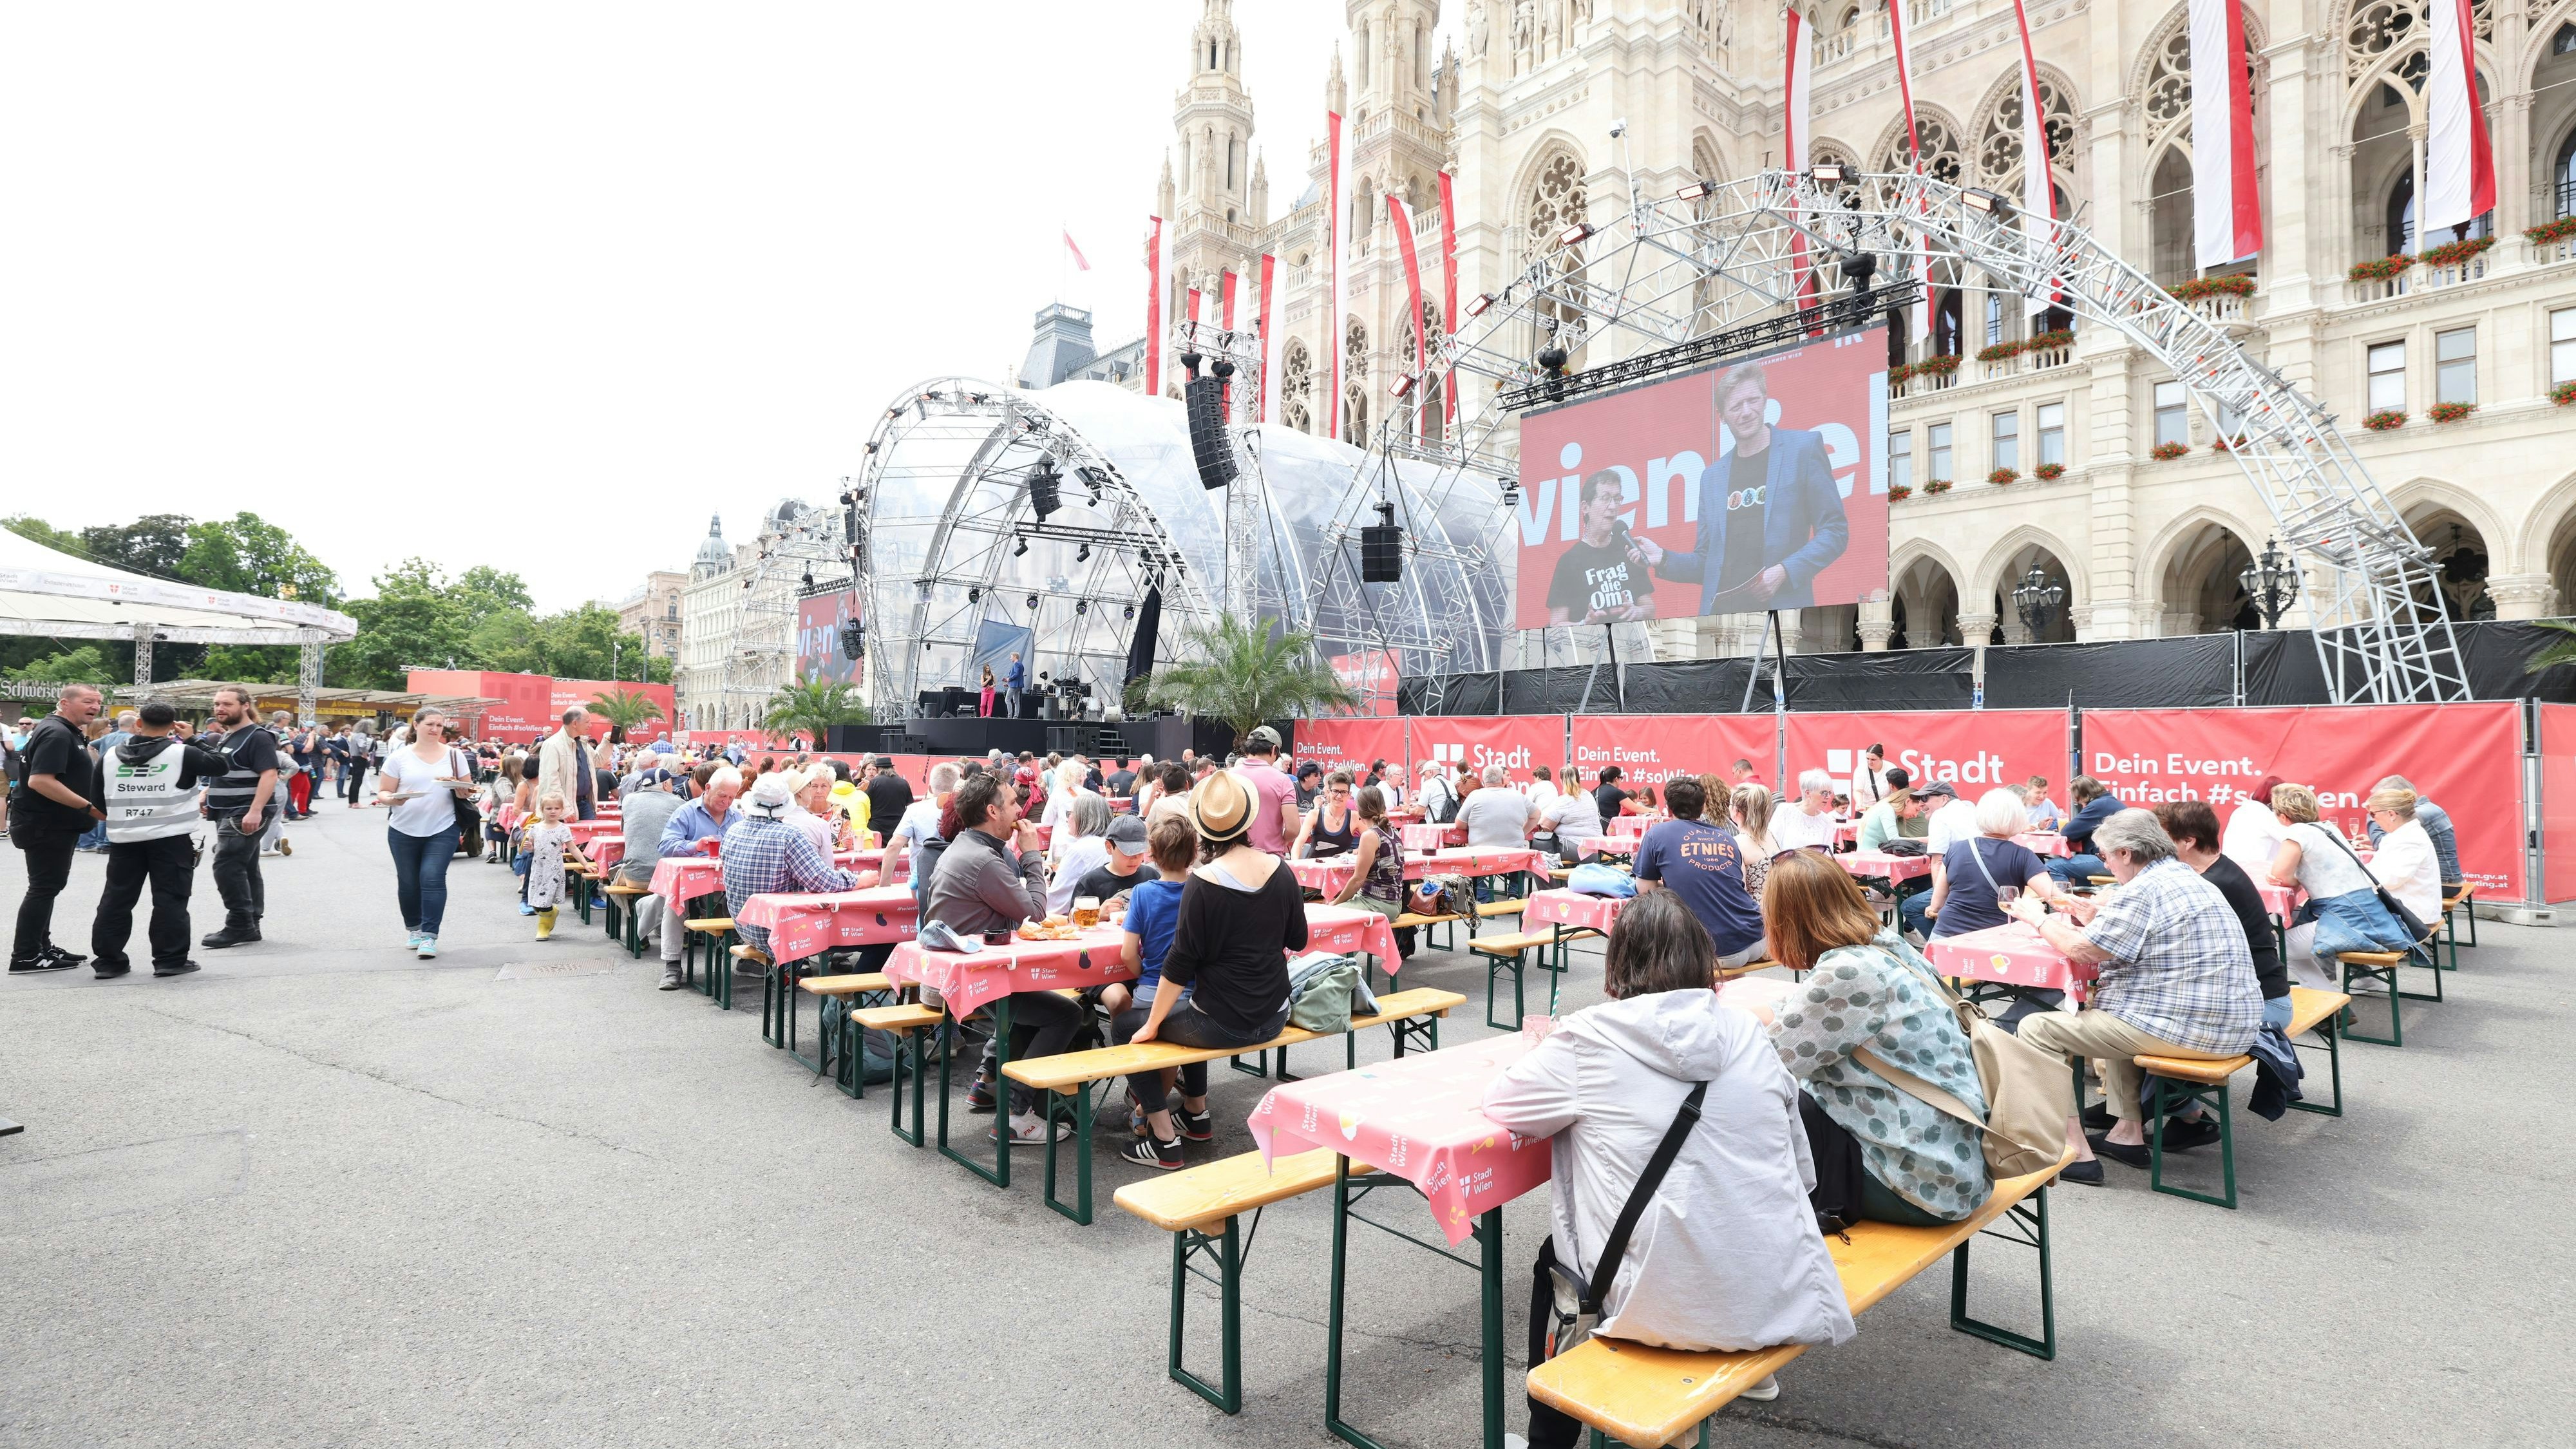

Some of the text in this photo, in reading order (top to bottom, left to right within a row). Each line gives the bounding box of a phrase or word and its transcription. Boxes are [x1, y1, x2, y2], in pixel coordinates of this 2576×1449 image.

[1586, 562, 1629, 585] Frag
[1600, 580, 1622, 592] die
[1297, 742, 1343, 755] Dein Event.
[1578, 746, 1661, 763] Dein Event.
[1473, 744, 1531, 770] Stadt
[2095, 752, 2262, 777] Dein Event.
[1900, 749, 2004, 784] Stadt
[117, 783, 166, 792] Steward
[126, 808, 154, 817] R747
[1683, 829, 1729, 842] QUALITY
[1680, 842, 1735, 859] ETNIES
[1689, 858, 1733, 871] PRODUCTS
[943, 979, 958, 994] Stadt
[947, 985, 961, 999] Wien
[974, 979, 988, 989] Stadt
[974, 986, 989, 995] Wien
[1302, 1102, 1312, 1130] Stadt
[1309, 1104, 1318, 1133] Wien
[1023, 1125, 1036, 1137] FILA
[1389, 1133, 1399, 1165] Stadt
[1397, 1137, 1408, 1168] Wien
[1426, 1161, 1447, 1188] Stadt
[1473, 1167, 1493, 1183] Stadt
[1431, 1173, 1452, 1196] Wien
[1473, 1180, 1493, 1195] Wien
